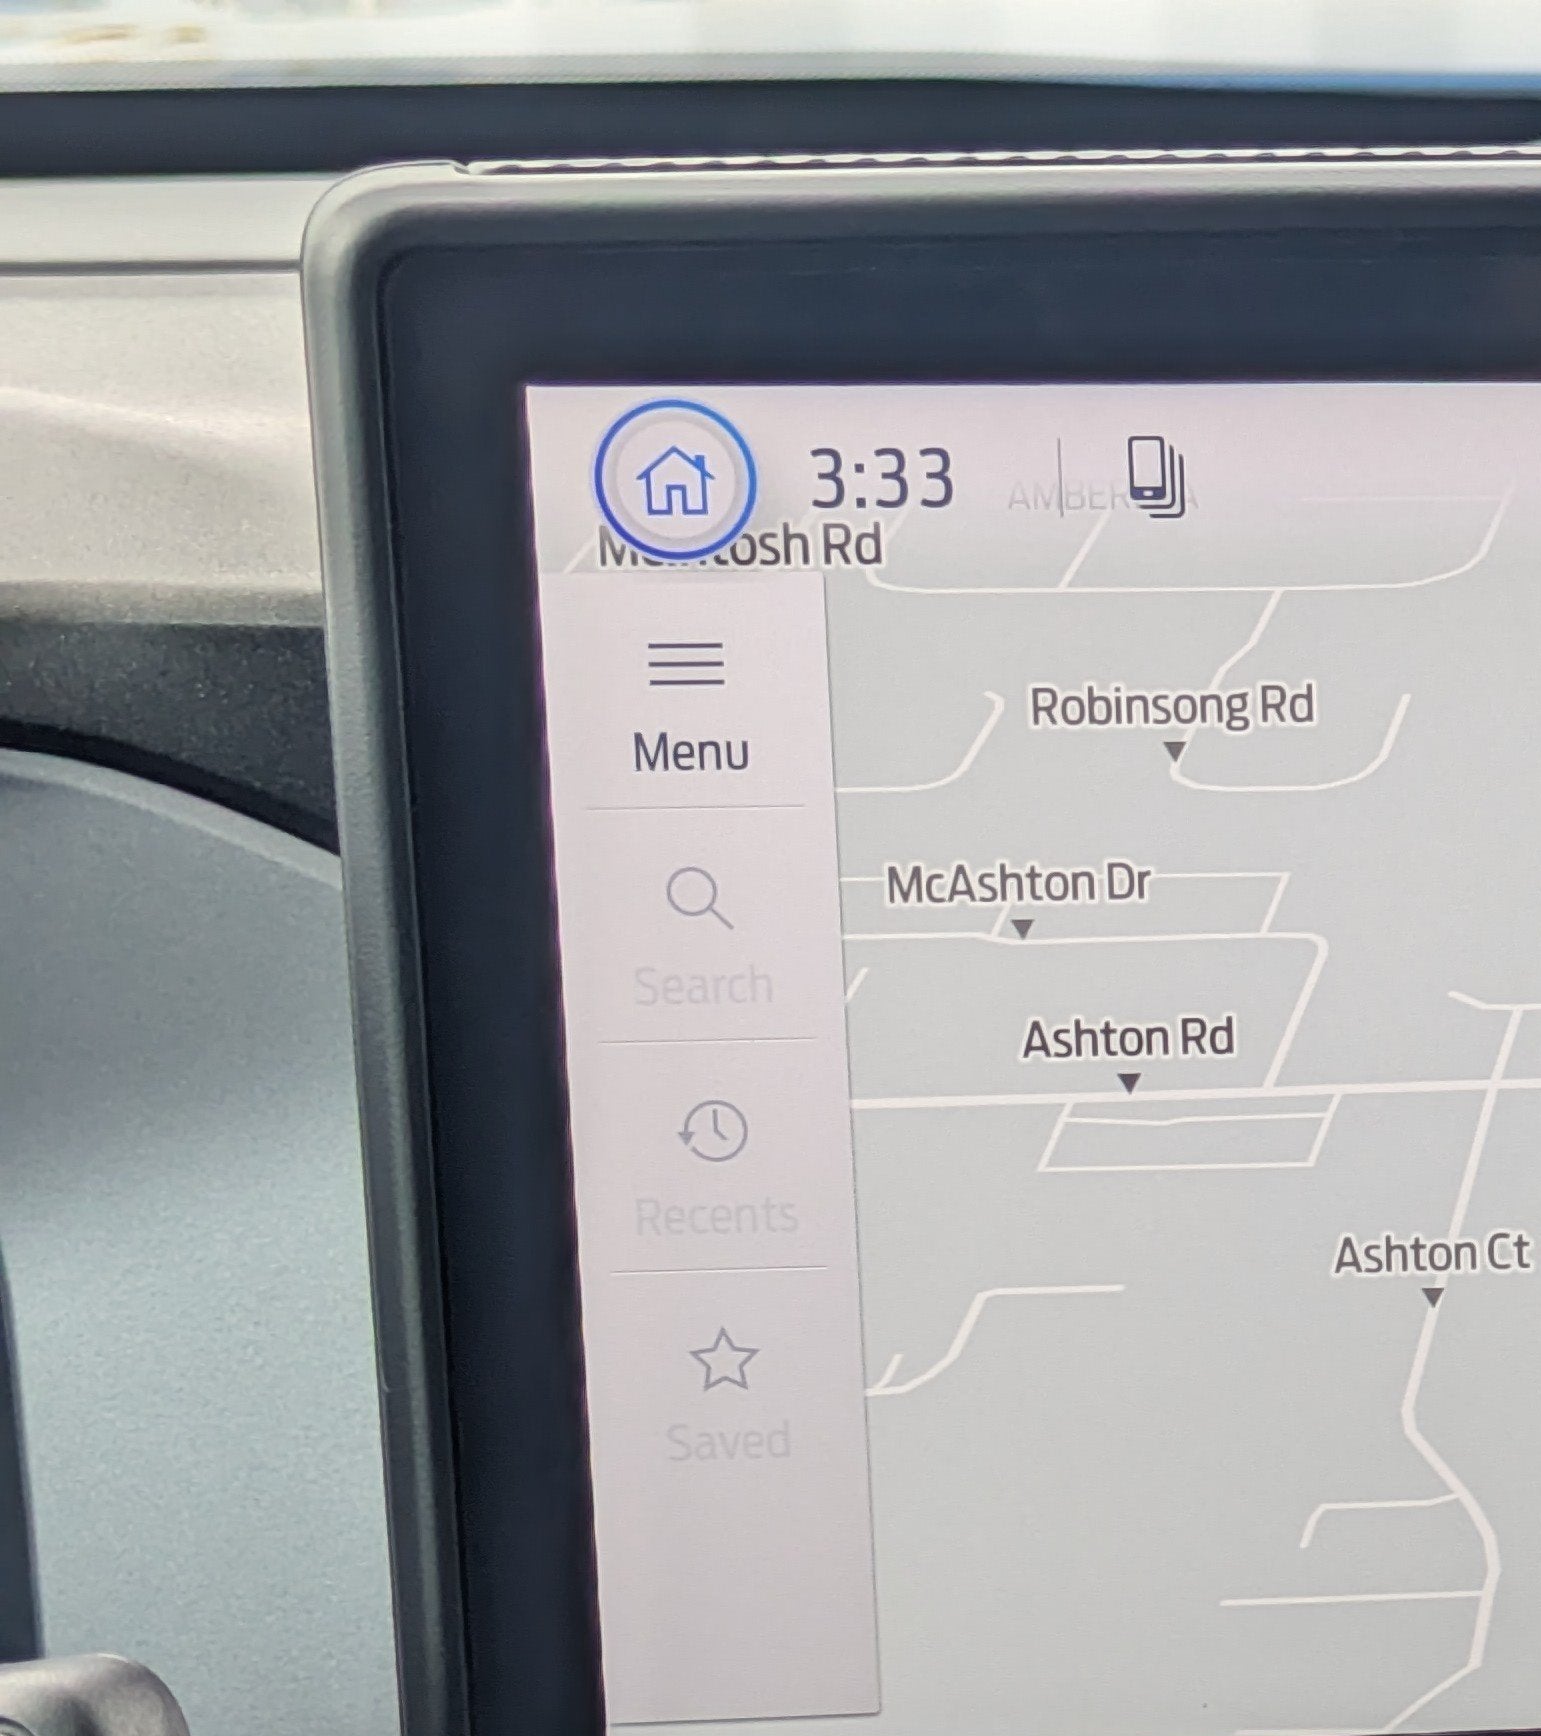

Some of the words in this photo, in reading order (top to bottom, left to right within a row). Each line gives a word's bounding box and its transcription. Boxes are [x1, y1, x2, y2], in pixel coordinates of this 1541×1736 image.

[810, 447, 953, 509] 3:33
[823, 521, 882, 565] Rd
[1032, 685, 1250, 731] Robinsong
[1261, 683, 1314, 723] Rd
[633, 731, 749, 772] Menu
[887, 863, 1095, 904] McAshton
[1107, 862, 1151, 900] Dr
[634, 966, 773, 1005] Search
[1023, 1019, 1169, 1058] Ashton
[1181, 1015, 1234, 1055] Rd
[635, 1197, 798, 1236] Recents
[1334, 1235, 1477, 1274] Ashton
[1487, 1232, 1531, 1270] Ct
[665, 1419, 791, 1463] Saved
